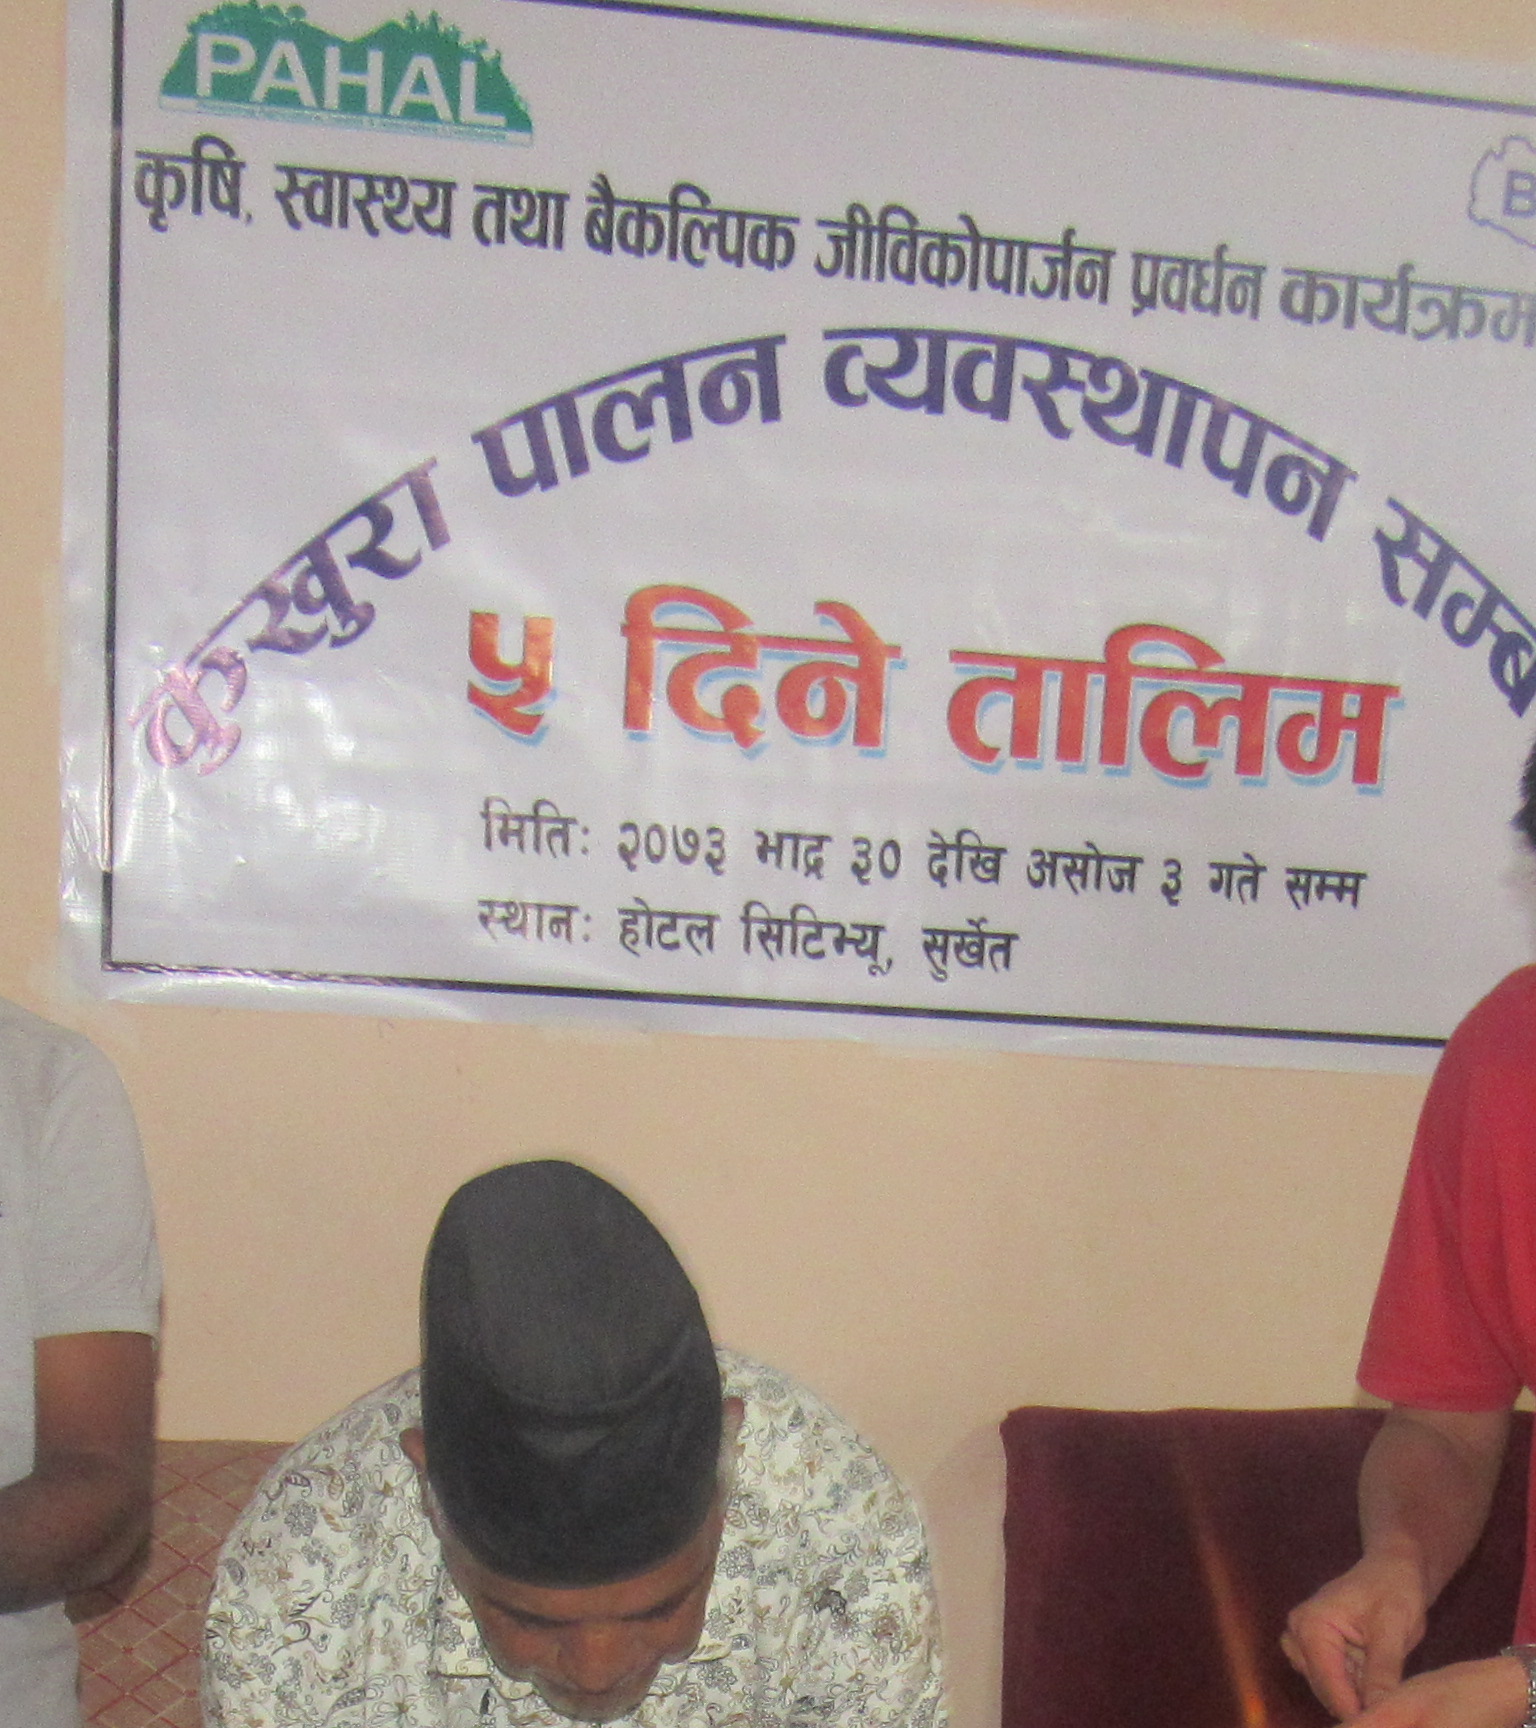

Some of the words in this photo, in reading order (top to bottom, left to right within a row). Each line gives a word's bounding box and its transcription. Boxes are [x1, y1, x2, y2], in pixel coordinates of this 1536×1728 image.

[195, 33, 507, 129] PAHAL
[274, 164, 457, 238] स्वास्थ्य
[472, 184, 570, 251] तथा
[584, 172, 801, 272] बैकल्पिक
[814, 202, 1117, 306] जीविकोपार्जन
[1131, 243, 1268, 320] प्रवर्धन
[128, 456, 451, 776] कुखुरा
[471, 334, 787, 498] पालन
[822, 326, 1359, 542] व्यवस्थापन
[467, 610, 559, 747] ५
[621, 583, 906, 752] दिने
[946, 621, 1403, 793] तालिम
[617, 821, 728, 877] २०७३
[754, 829, 833, 880] भाद्र
[850, 835, 902, 886] ३०
[927, 828, 1008, 888] देखि
[1027, 840, 1145, 896] असोज
[1161, 857, 1183, 907] ३
[1208, 851, 1268, 905] गते
[1284, 866, 1368, 910] सम्म
[617, 896, 721, 957] होटल
[921, 917, 1020, 983] सुर्खेत
